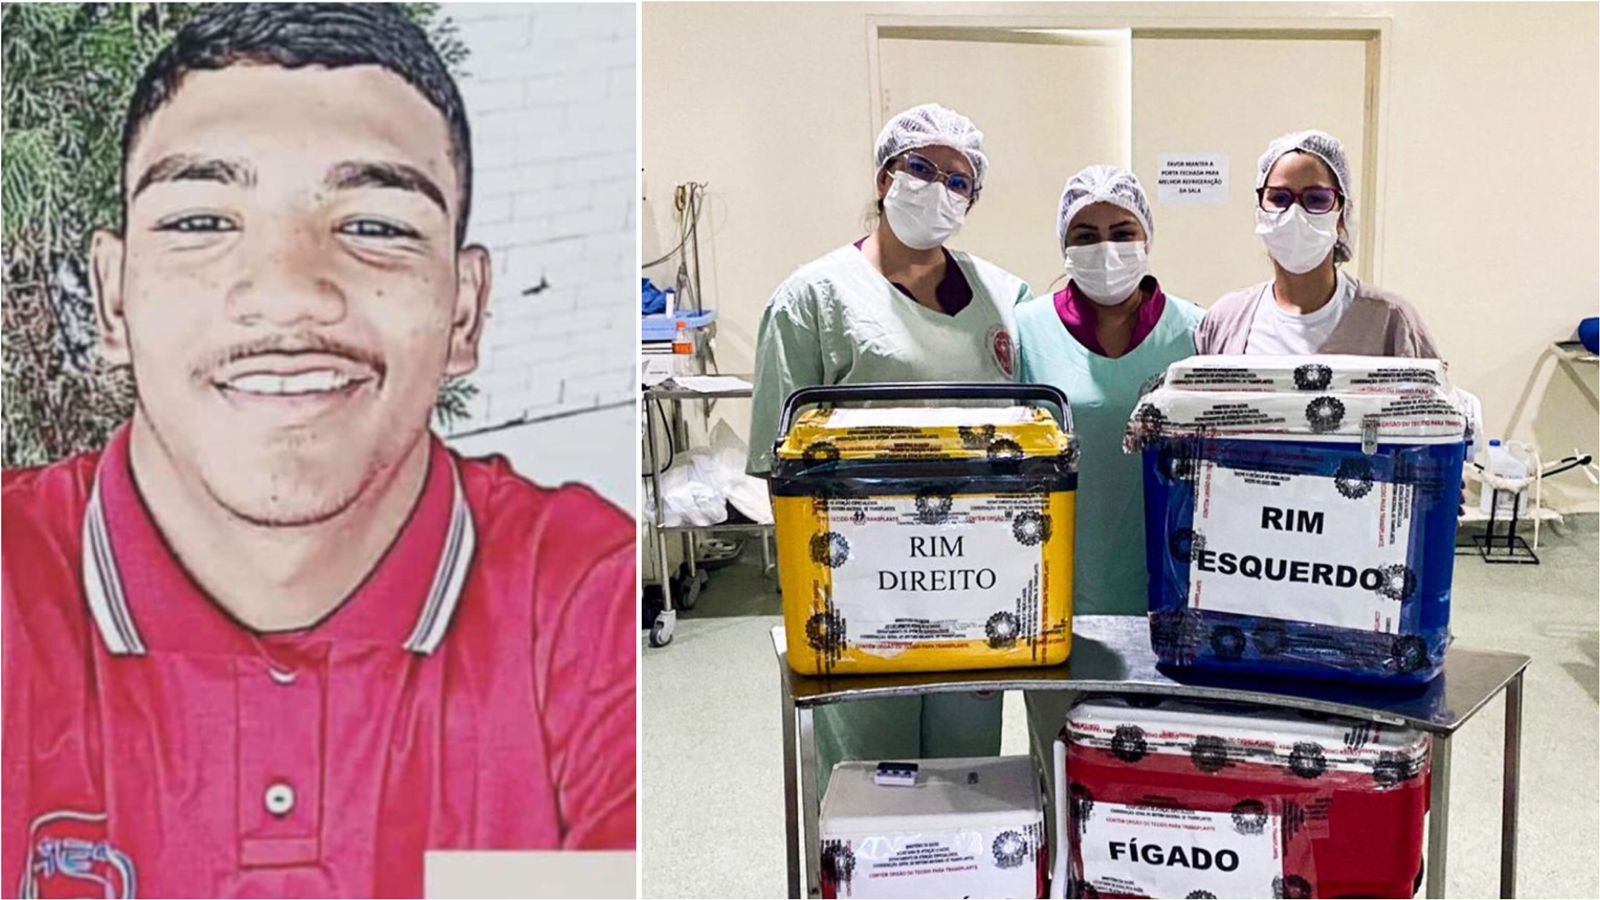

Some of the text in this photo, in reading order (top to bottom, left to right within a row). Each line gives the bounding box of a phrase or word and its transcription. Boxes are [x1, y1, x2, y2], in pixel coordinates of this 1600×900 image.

[1261, 506, 1324, 534] RIM
[910, 535, 964, 558] RIM
[878, 568, 996, 592] DIREITO
[1197, 550, 1383, 592] ESQUERDO
[1109, 838, 1240, 872] FÍGADO
